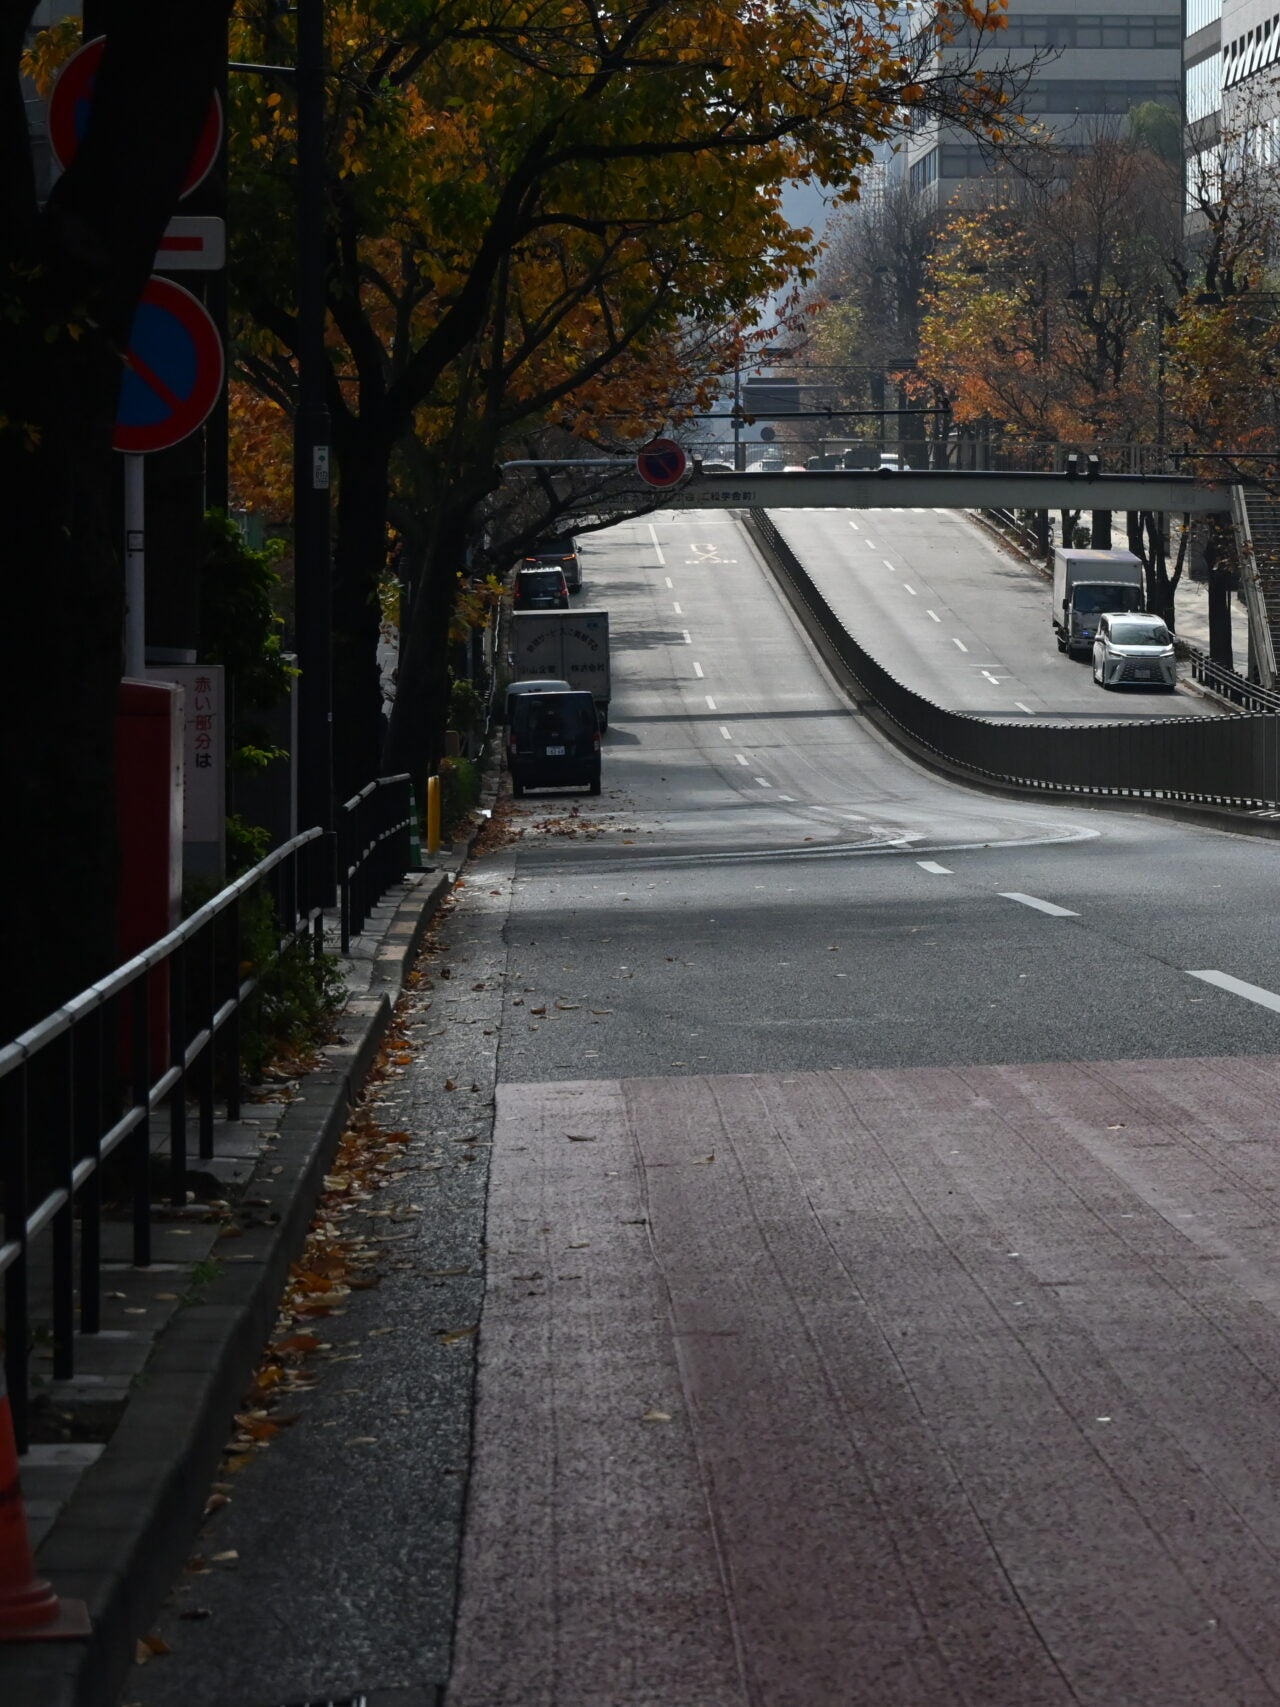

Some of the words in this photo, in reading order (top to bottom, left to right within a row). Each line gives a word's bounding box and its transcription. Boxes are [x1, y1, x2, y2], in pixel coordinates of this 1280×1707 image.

[195, 676, 211, 768] 赤い部分は
